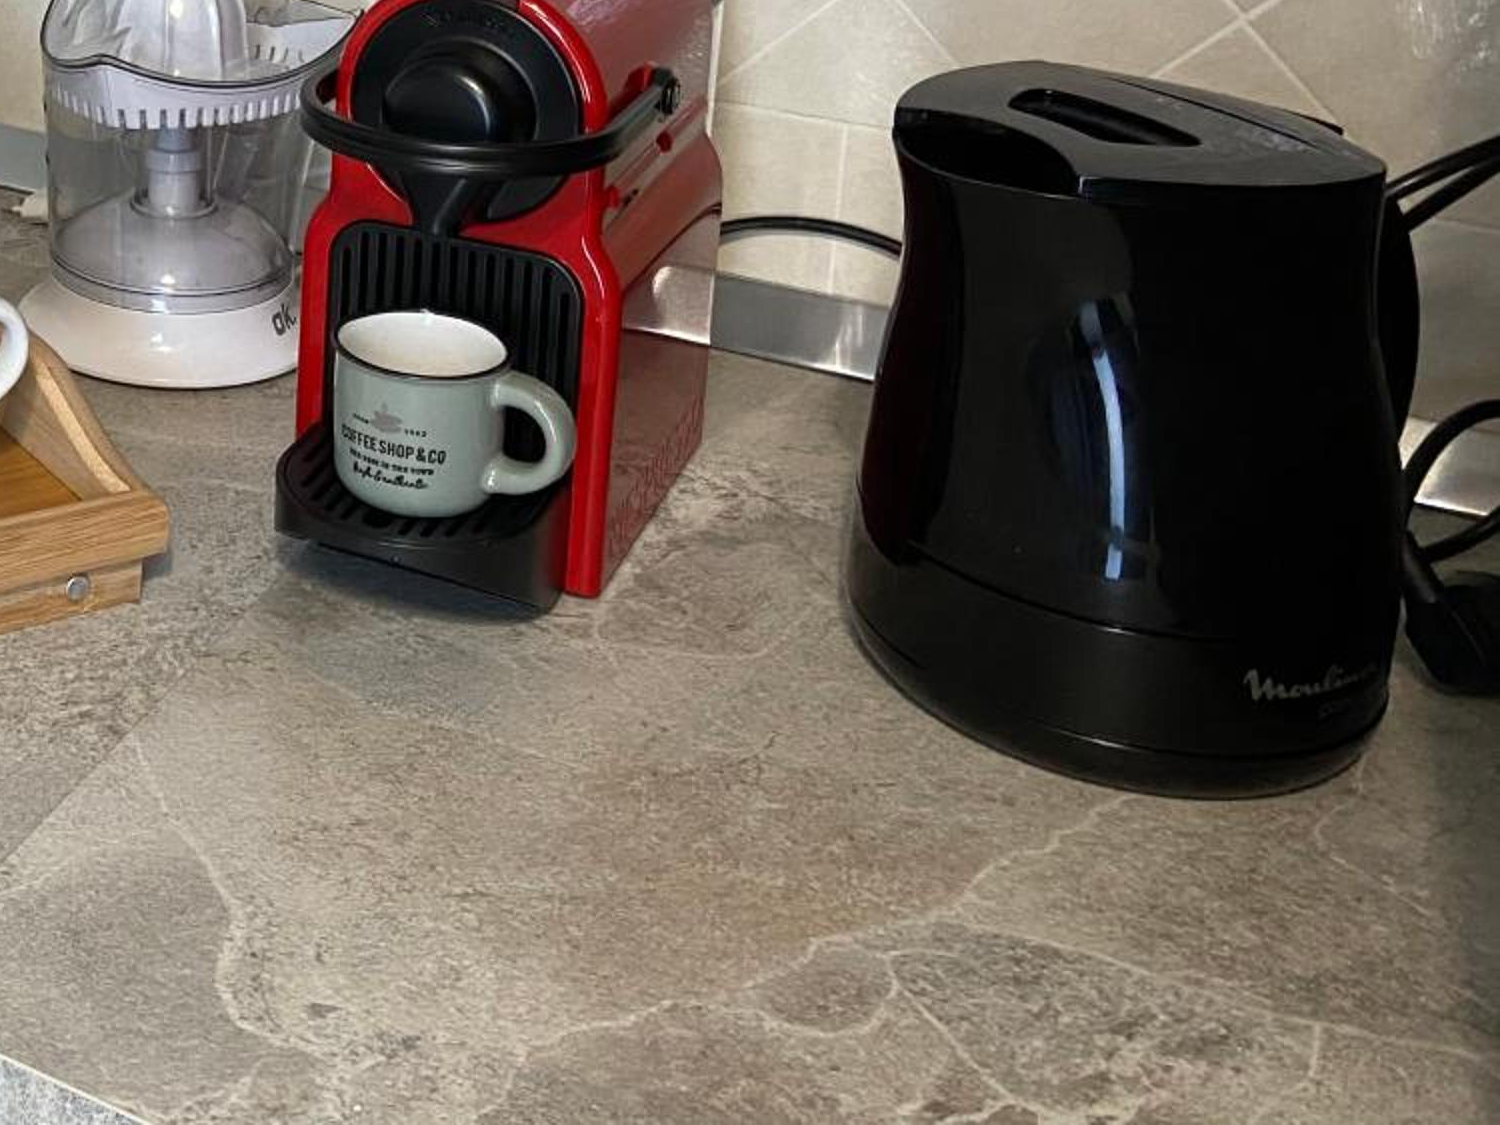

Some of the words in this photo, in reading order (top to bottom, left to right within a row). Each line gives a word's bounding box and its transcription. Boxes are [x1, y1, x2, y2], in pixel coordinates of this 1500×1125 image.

[341, 423, 377, 452] COFFEE
[379, 440, 415, 460] SHOP
[416, 447, 426, 463] &
[427, 449, 447, 465] CO
